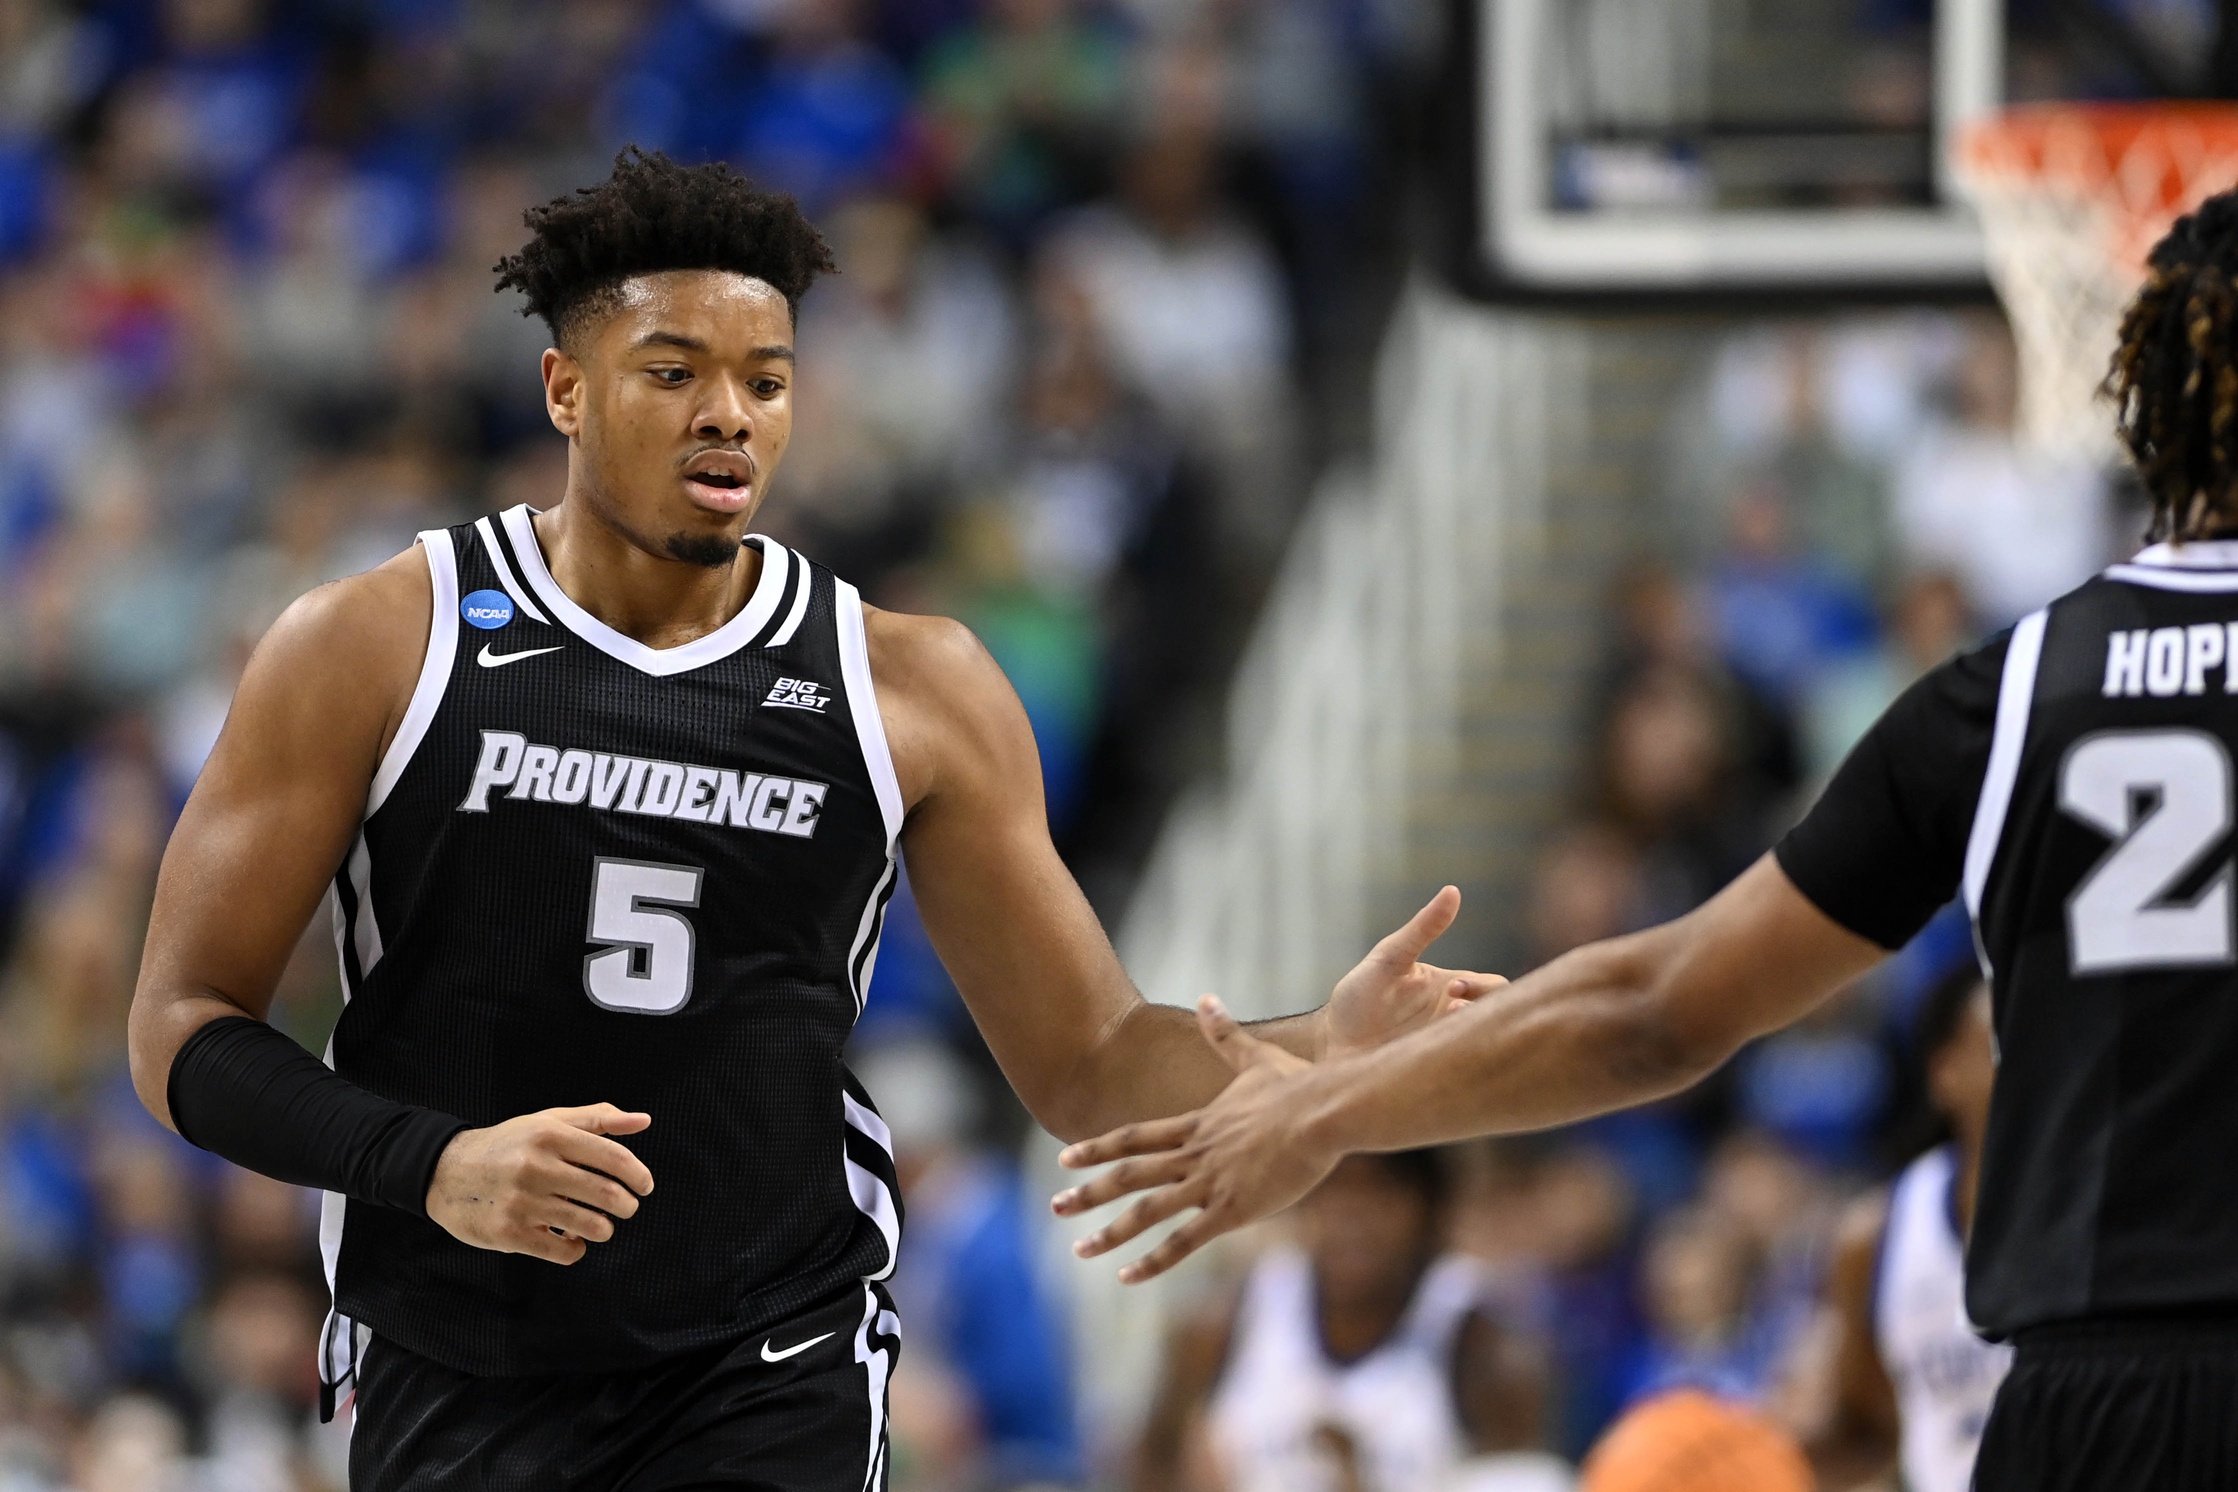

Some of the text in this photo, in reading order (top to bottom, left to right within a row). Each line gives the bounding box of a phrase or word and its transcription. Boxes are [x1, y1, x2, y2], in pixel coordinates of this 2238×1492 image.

[467, 607, 510, 619] NCAA
[773, 677, 819, 694] BIG
[766, 689, 831, 708] EAST
[456, 729, 829, 838] PROVIDENCE
[583, 856, 705, 1016] 5
